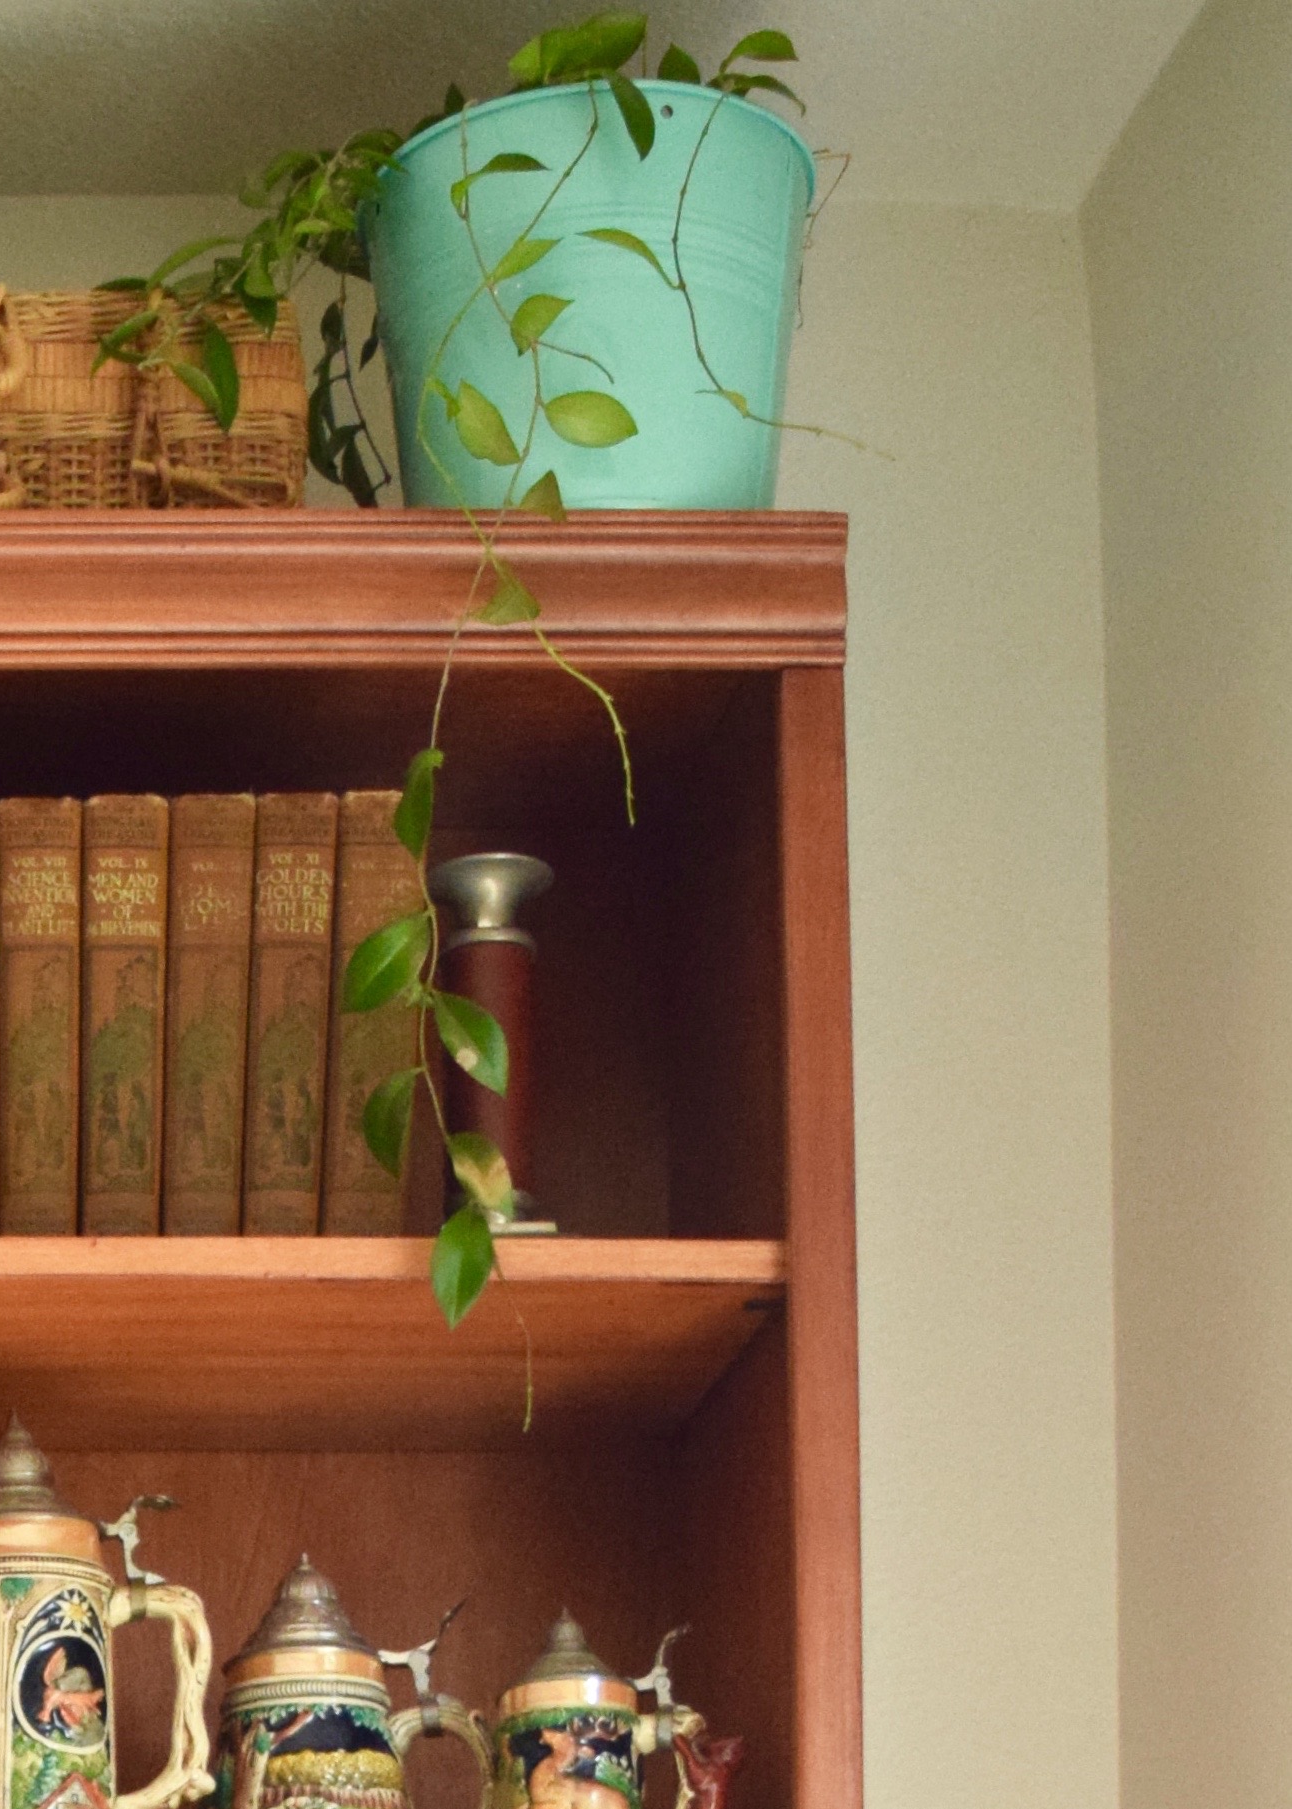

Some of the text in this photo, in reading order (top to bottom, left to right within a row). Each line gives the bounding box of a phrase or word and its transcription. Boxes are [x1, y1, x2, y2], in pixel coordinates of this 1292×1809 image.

[88, 873, 159, 888] MEN AND
[256, 870, 333, 886] GOLDEN
[92, 888, 159, 904] WOMEN
[261, 885, 330, 902] HOURS
[113, 903, 133, 920] OF
